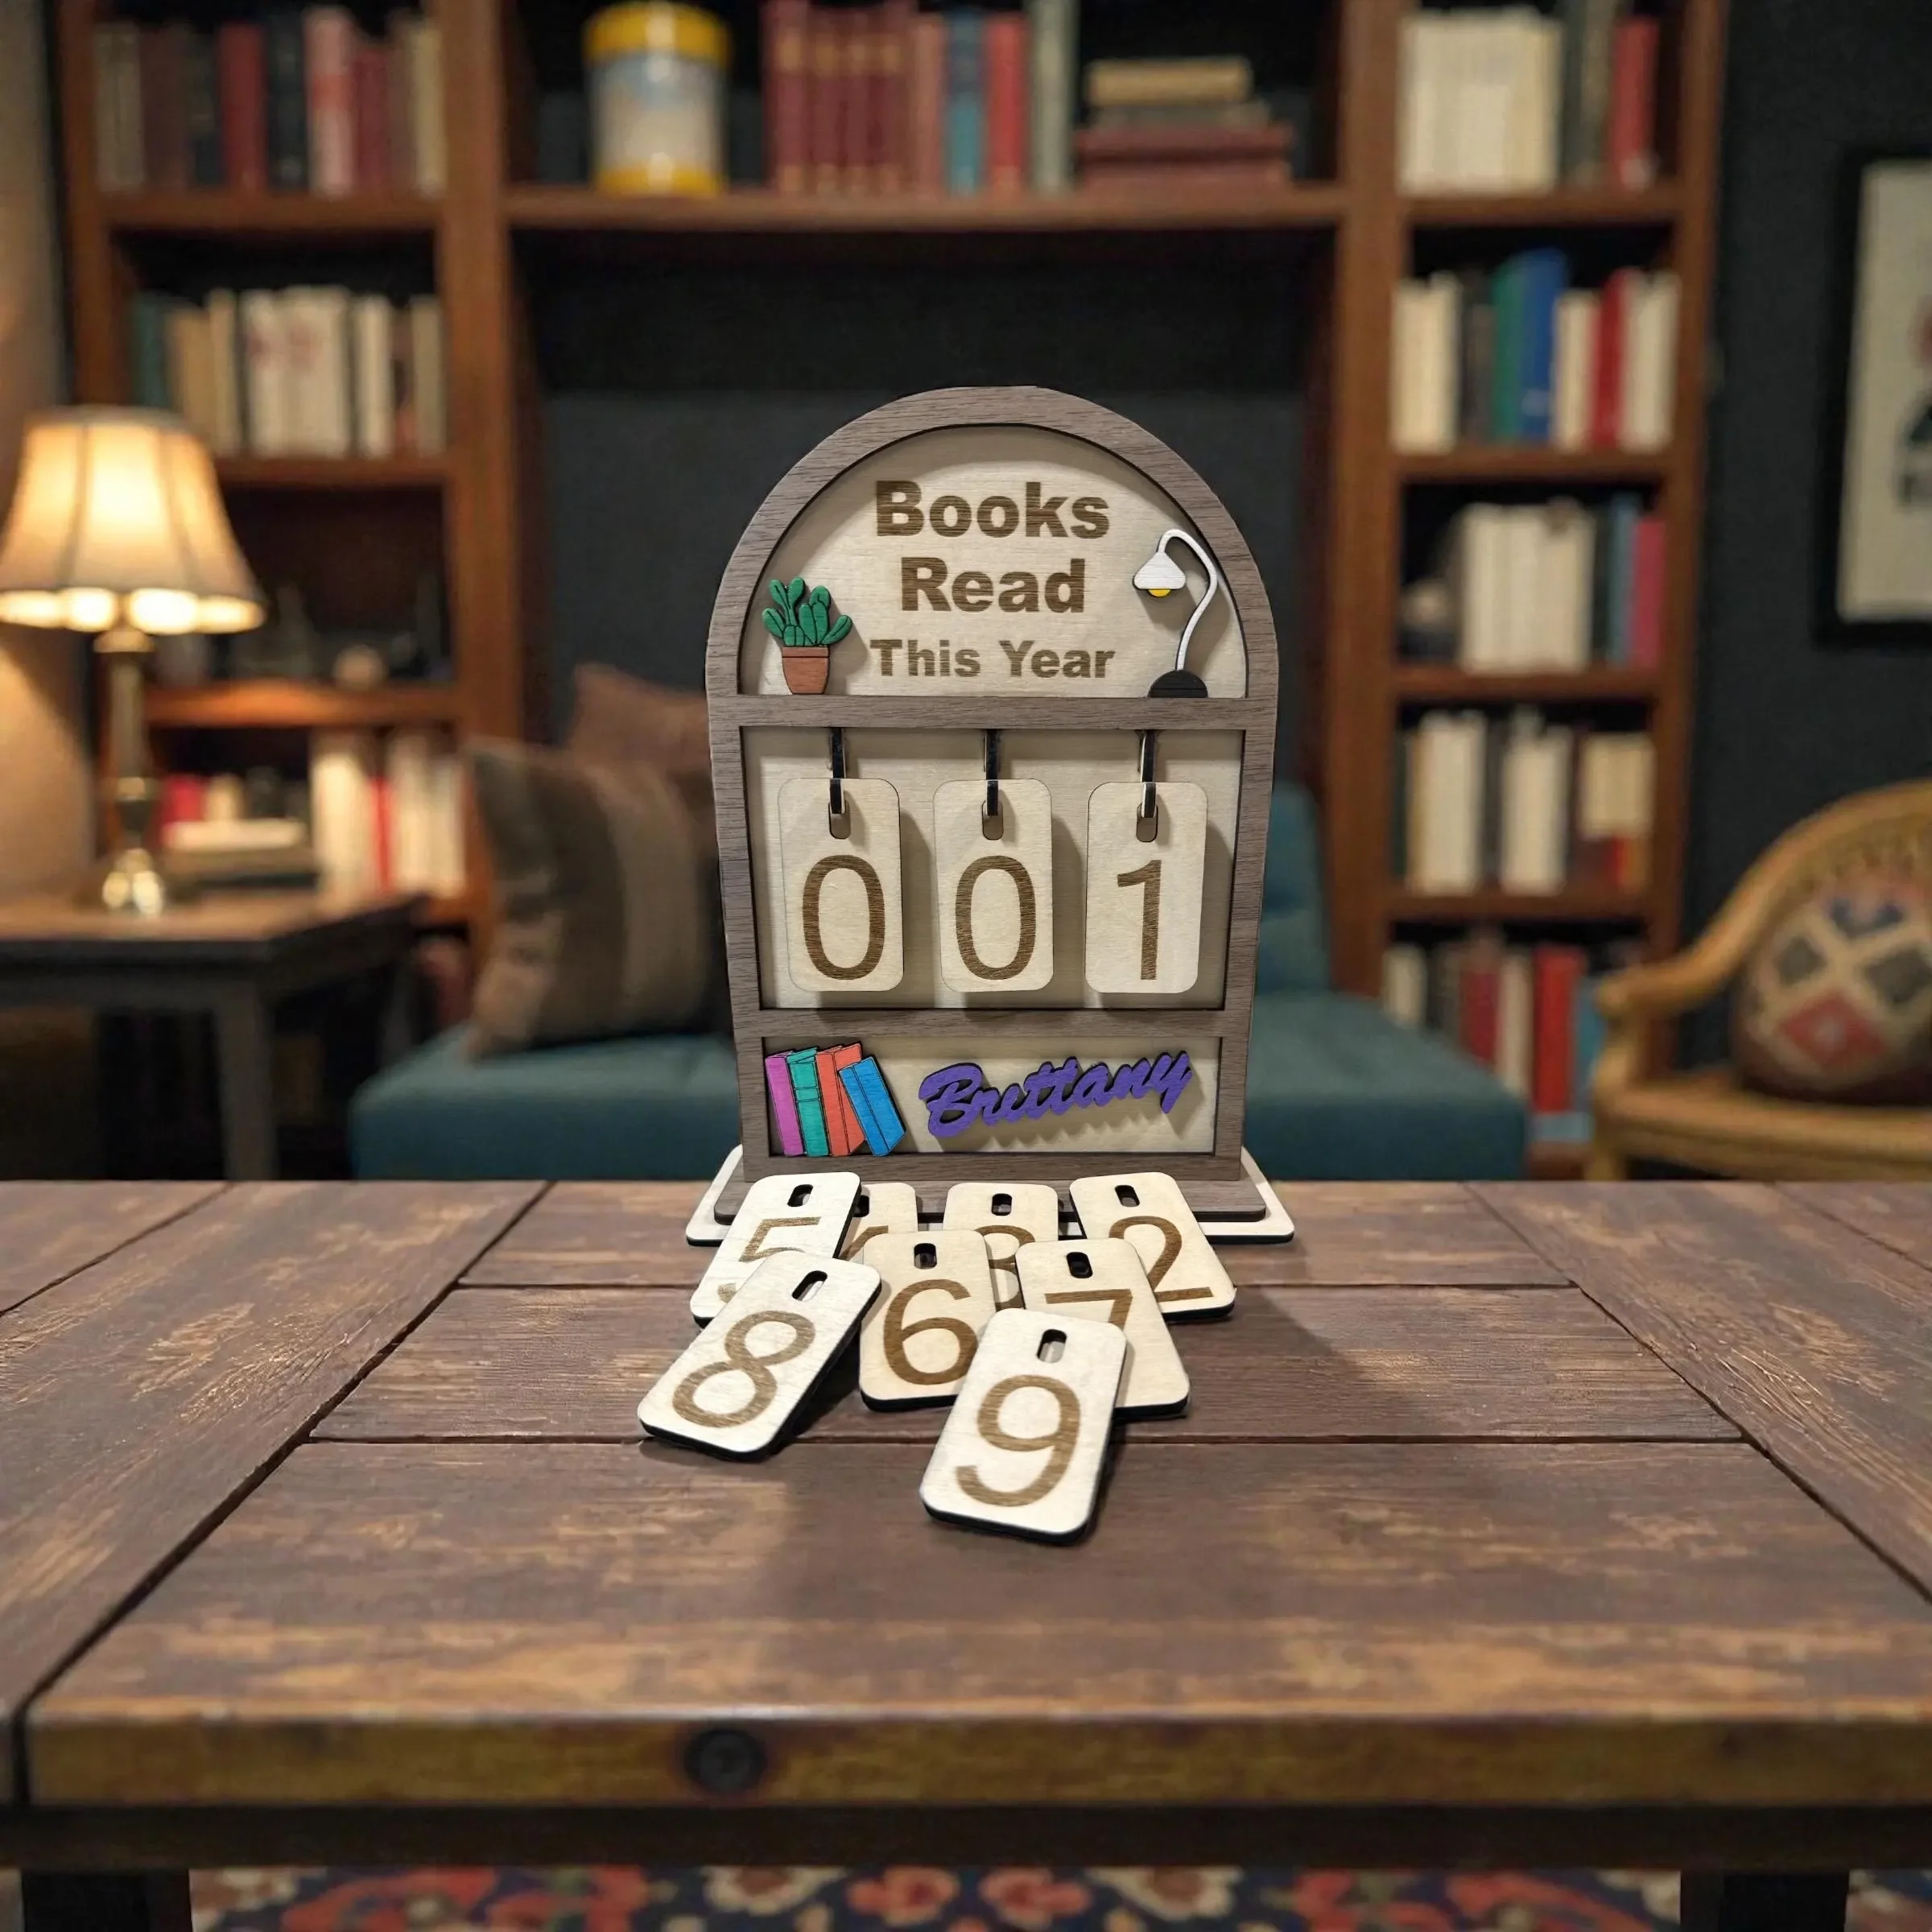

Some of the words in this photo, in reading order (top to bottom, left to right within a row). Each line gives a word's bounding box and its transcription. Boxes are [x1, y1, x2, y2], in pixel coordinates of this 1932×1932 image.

[876, 481, 1110, 539] Books
[901, 557, 1085, 613] Read
[869, 640, 980, 676] This
[999, 640, 1116, 678] Year
[919, 1051, 1192, 1137] Brittany
[1108, 1216, 1214, 1302] 2
[672, 1310, 815, 1427] 8
[884, 1278, 978, 1385] 6
[955, 1374, 1080, 1506] 9
